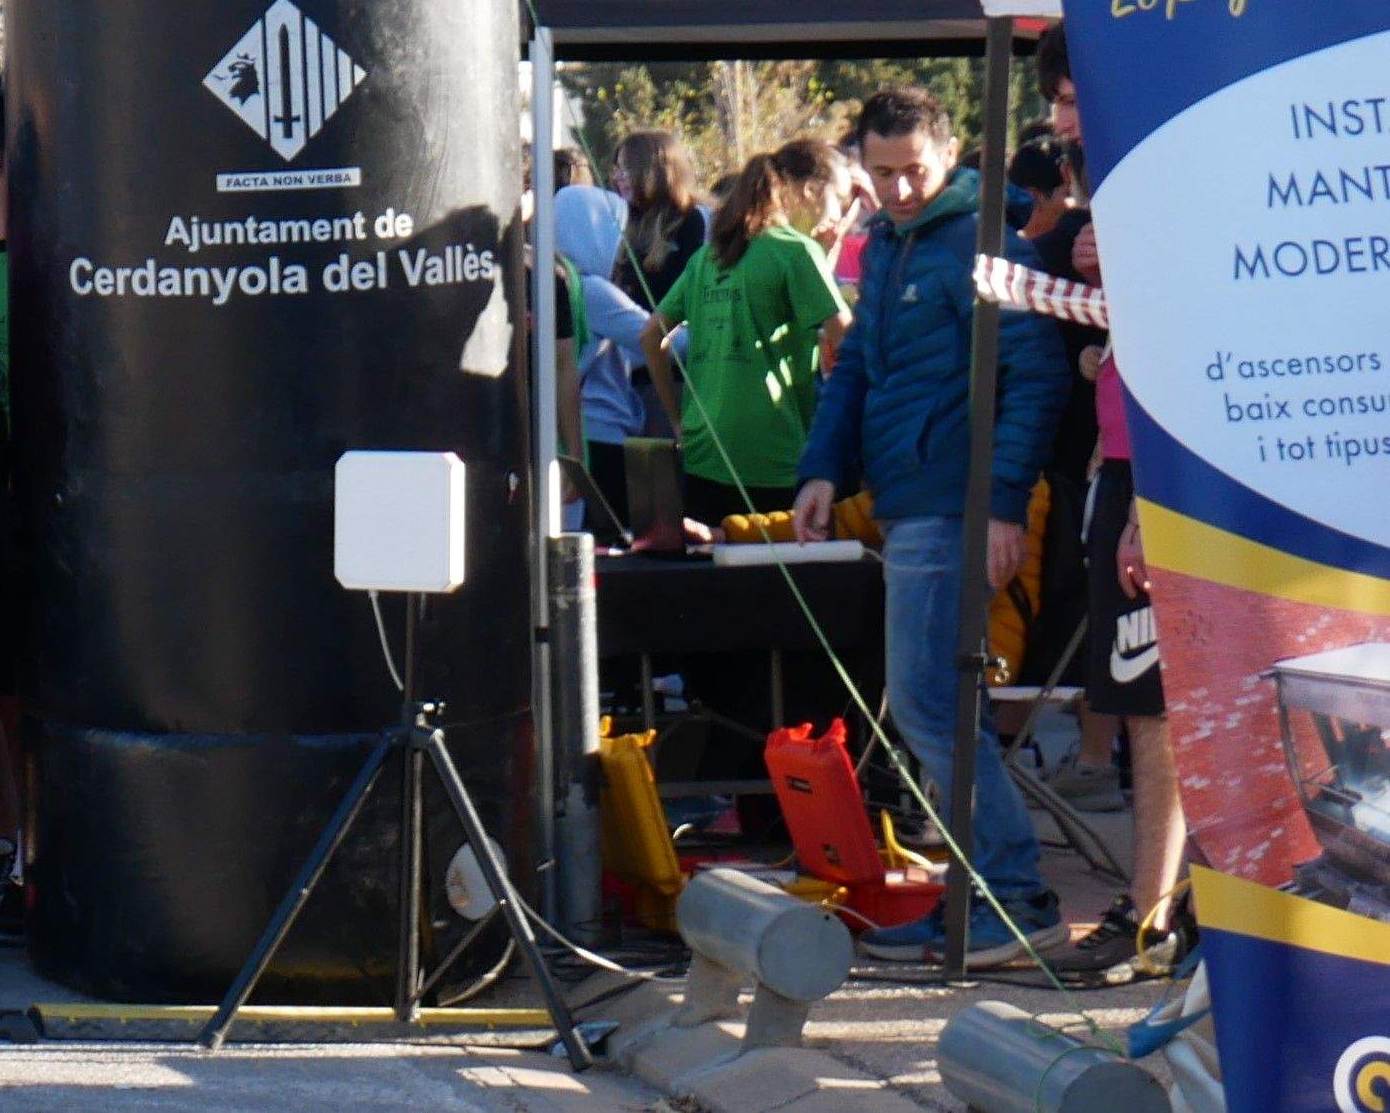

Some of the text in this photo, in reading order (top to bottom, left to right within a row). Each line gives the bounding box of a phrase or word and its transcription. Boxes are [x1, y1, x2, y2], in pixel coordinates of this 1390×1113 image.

[226, 173, 352, 188] FACTA NON VERBA
[165, 207, 414, 252] Ajuntament de
[69, 243, 496, 306] Cerdanyola del Vallès
[1234, 236, 1390, 279] MODER
[1206, 351, 1381, 381] d'ascensors
[1225, 392, 1291, 422] baix
[1257, 431, 1390, 466] i tot tipus
